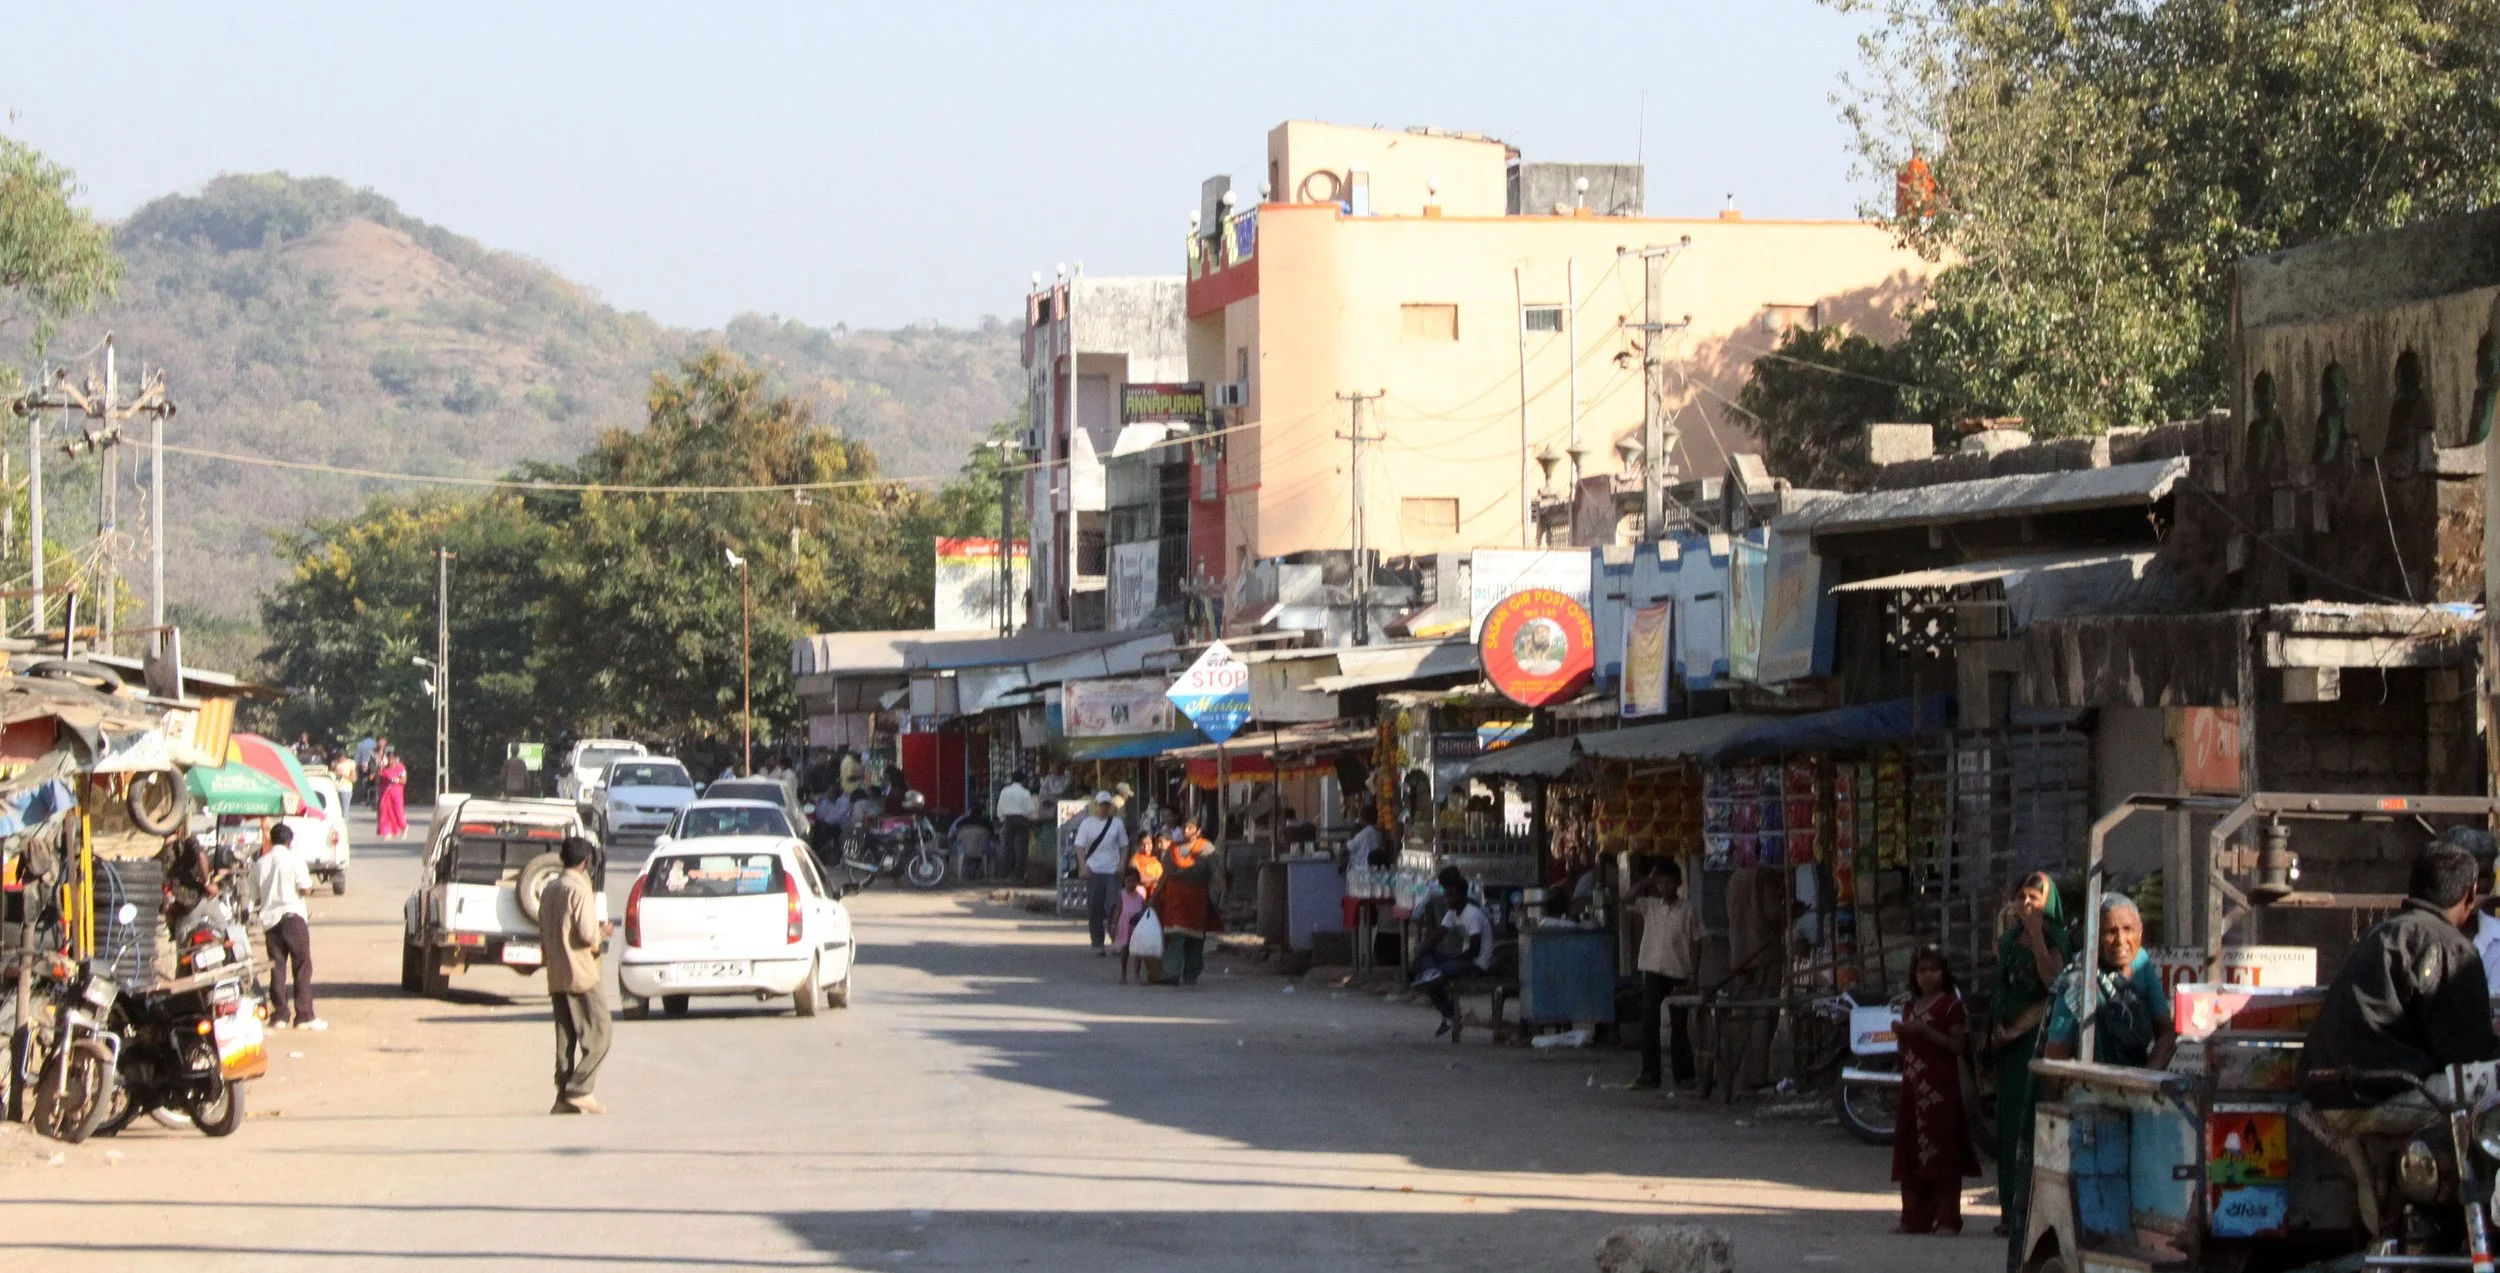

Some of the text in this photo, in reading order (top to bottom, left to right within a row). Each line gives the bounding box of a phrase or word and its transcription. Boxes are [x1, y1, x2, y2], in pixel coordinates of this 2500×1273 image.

[1509, 591, 1531, 611] GIR
[1534, 590, 1567, 607] POST
[1192, 670, 1247, 688] STOP
[2161, 964, 2264, 999] OEL
